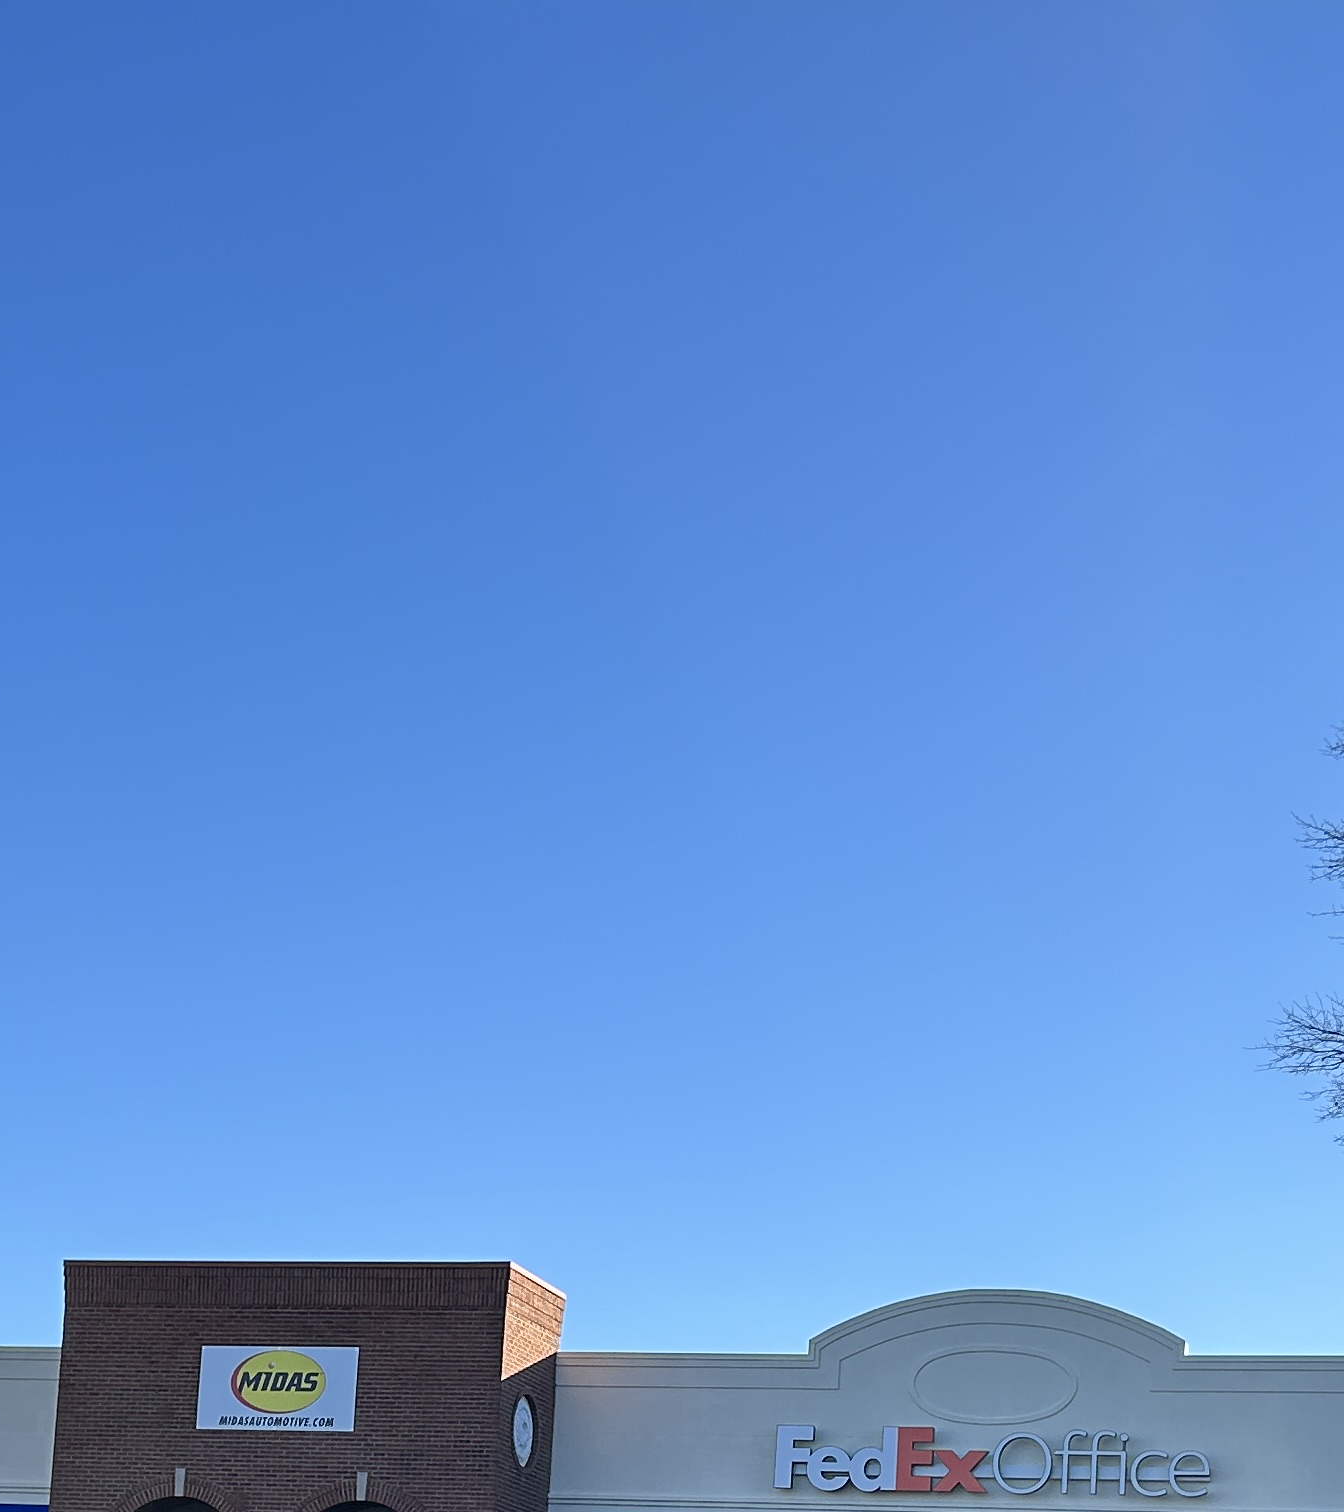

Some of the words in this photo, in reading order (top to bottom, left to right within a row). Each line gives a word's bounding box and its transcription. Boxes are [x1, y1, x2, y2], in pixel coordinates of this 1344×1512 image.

[237, 1371, 320, 1395] MIDAS
[218, 1415, 335, 1428] MIDASAUTOMOTIVE.COM
[772, 1423, 991, 1494] FedEx
[991, 1428, 1212, 1498] Office
